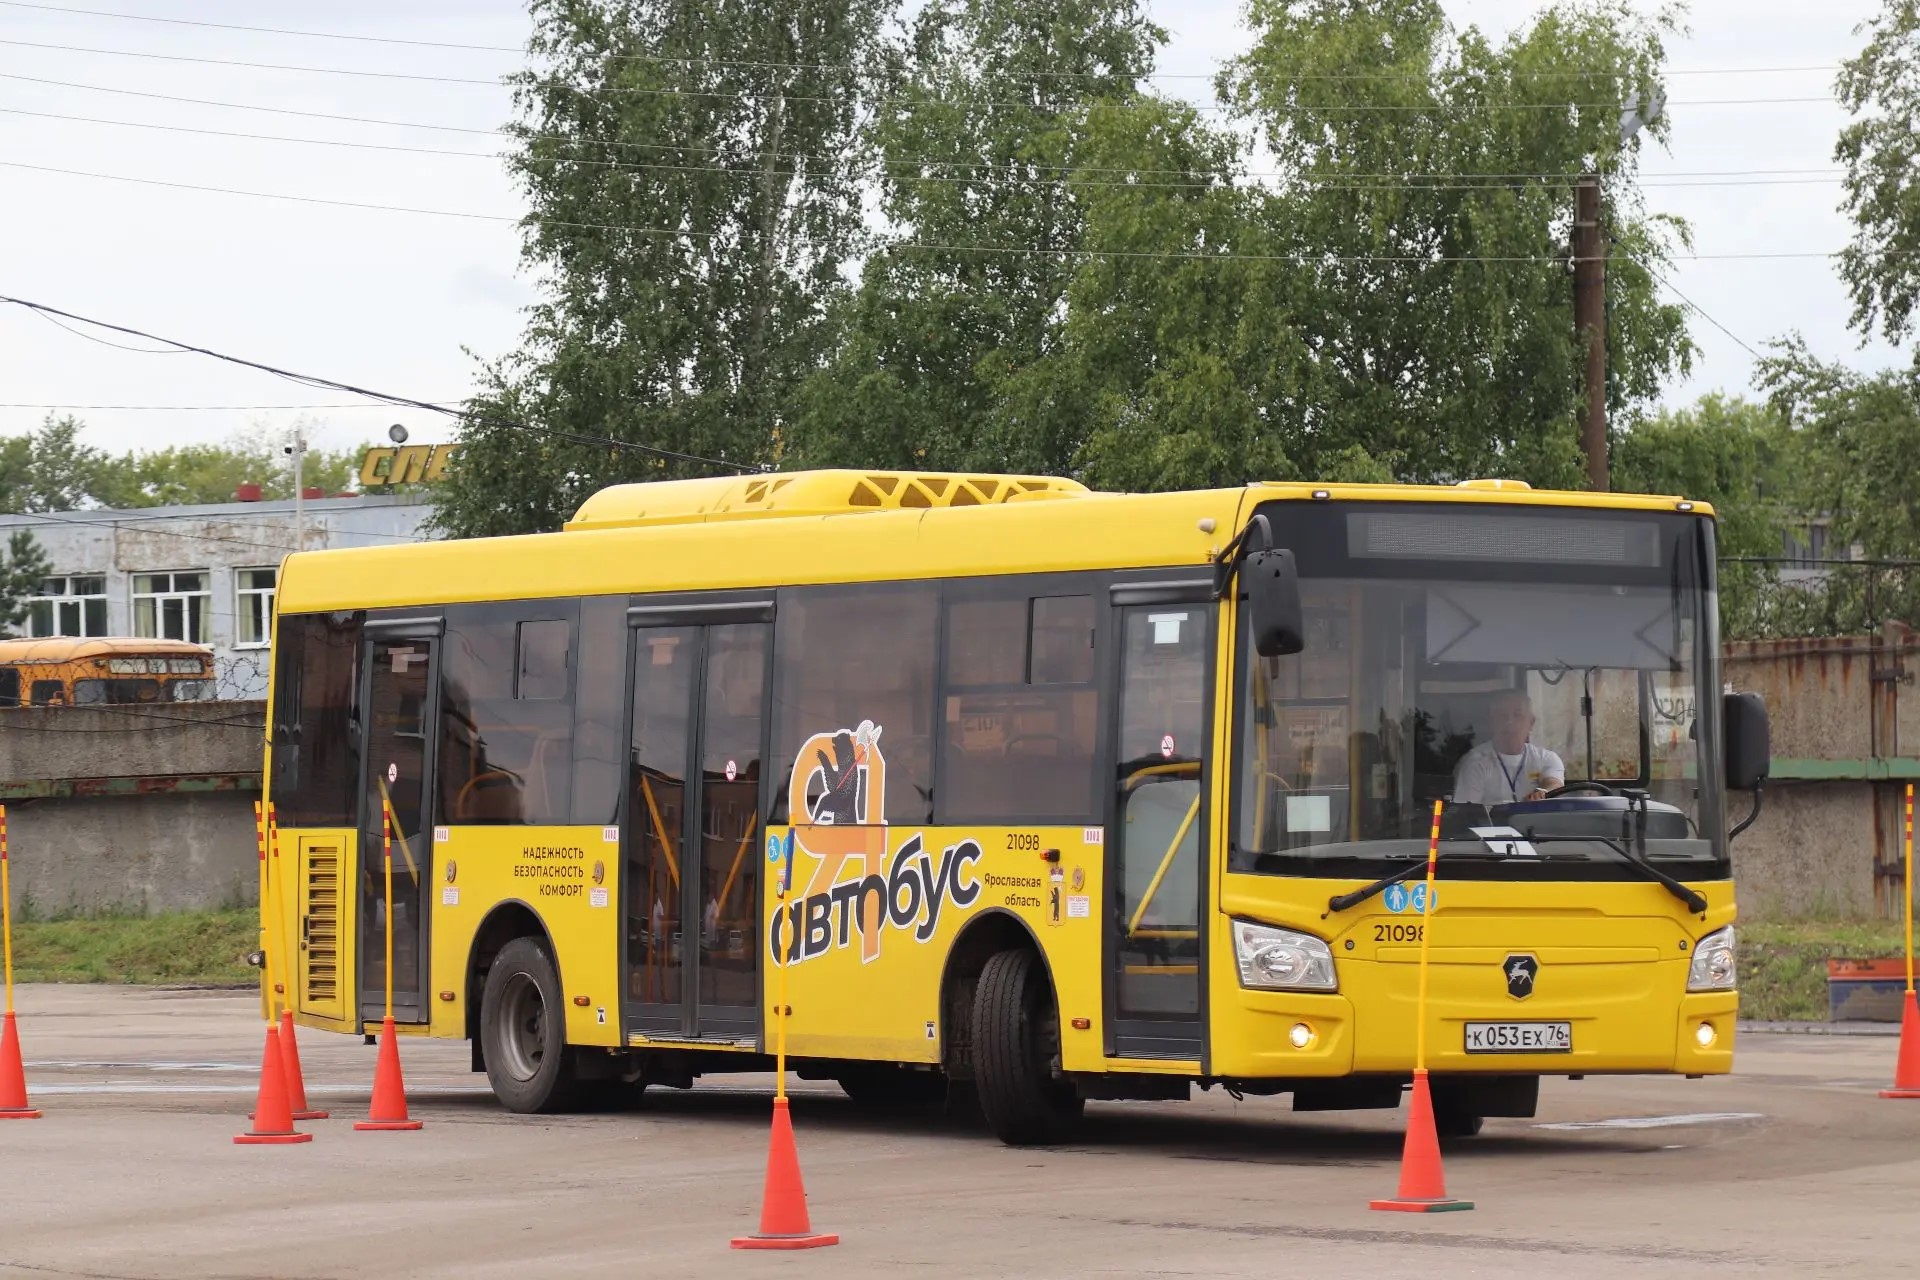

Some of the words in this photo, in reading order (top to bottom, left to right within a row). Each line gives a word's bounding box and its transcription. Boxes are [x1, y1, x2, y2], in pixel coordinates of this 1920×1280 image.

[1007, 834, 1040, 850] 21098
[523, 847, 584, 860] НАДЕЖНОСТЬ
[514, 865, 584, 878] БЕЗОПАСНОСТЬ
[984, 873, 1041, 888] Ярославская
[539, 884, 584, 897] КОМФОРТ
[1005, 893, 1041, 907] область
